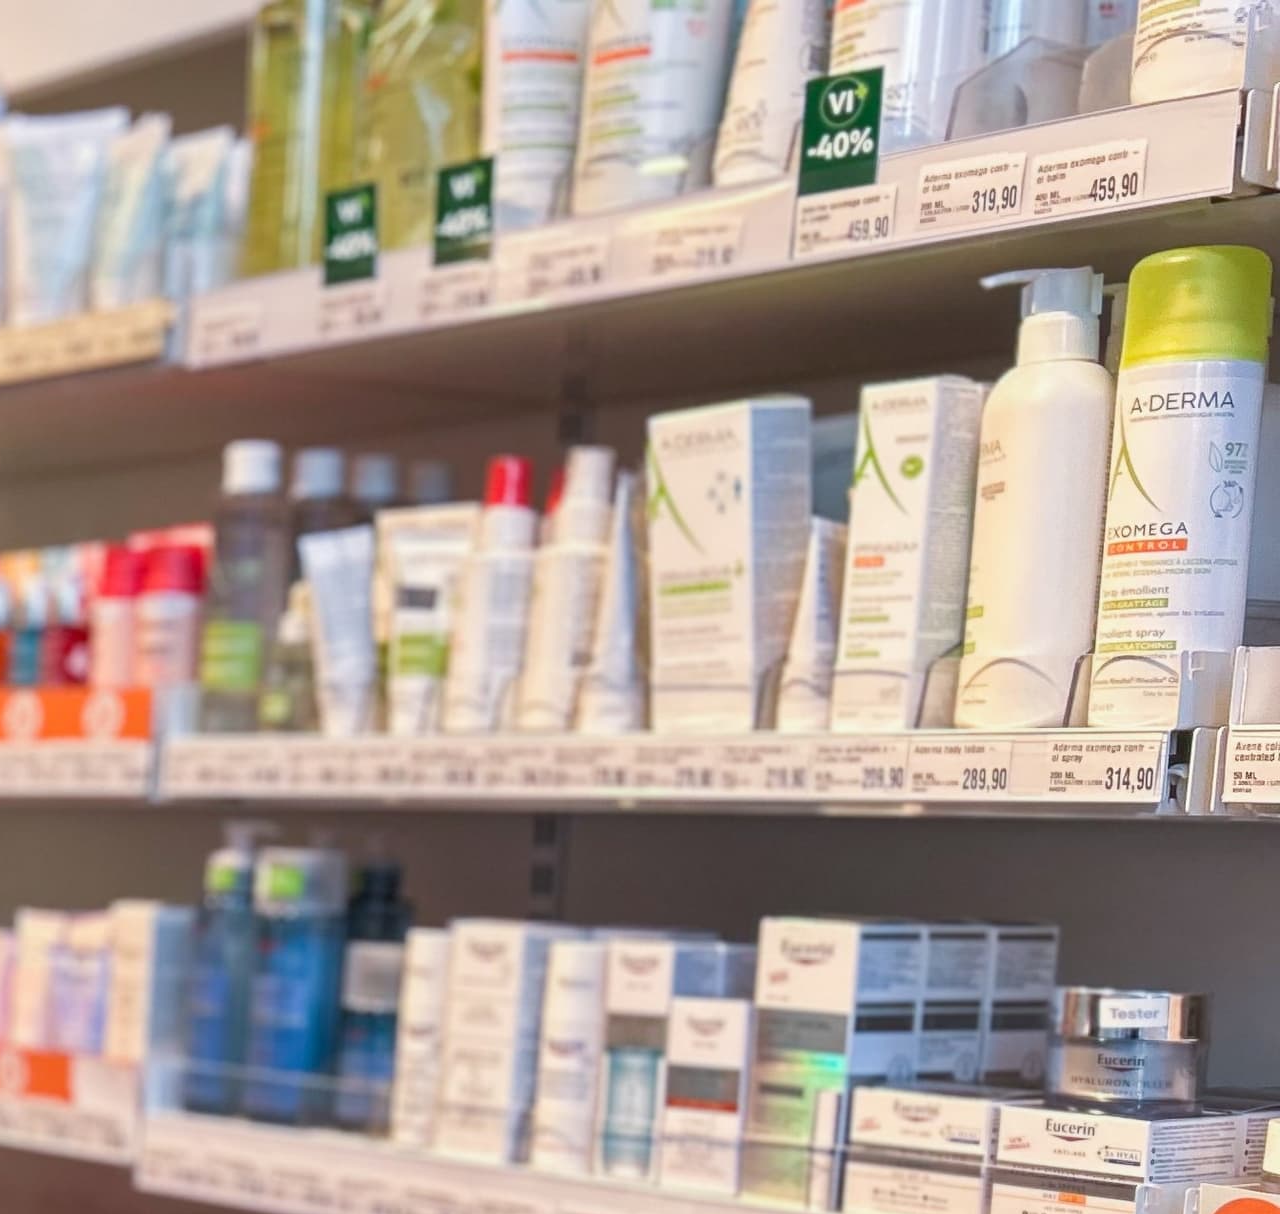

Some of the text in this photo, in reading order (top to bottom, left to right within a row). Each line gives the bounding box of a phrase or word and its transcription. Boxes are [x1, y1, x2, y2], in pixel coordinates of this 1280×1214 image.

[807, 127, 874, 160] -40%
[972, 185, 1017, 214] 319,90
[1090, 172, 1138, 203] 459,90
[1107, 521, 1188, 540] EXOMEGA
[962, 768, 1007, 792] 289,90
[1105, 767, 1154, 793] 314,90
[1110, 1008, 1160, 1020] Tester
[1097, 1053, 1145, 1067] Eucerin
[1045, 1118, 1097, 1137] Eucerin
